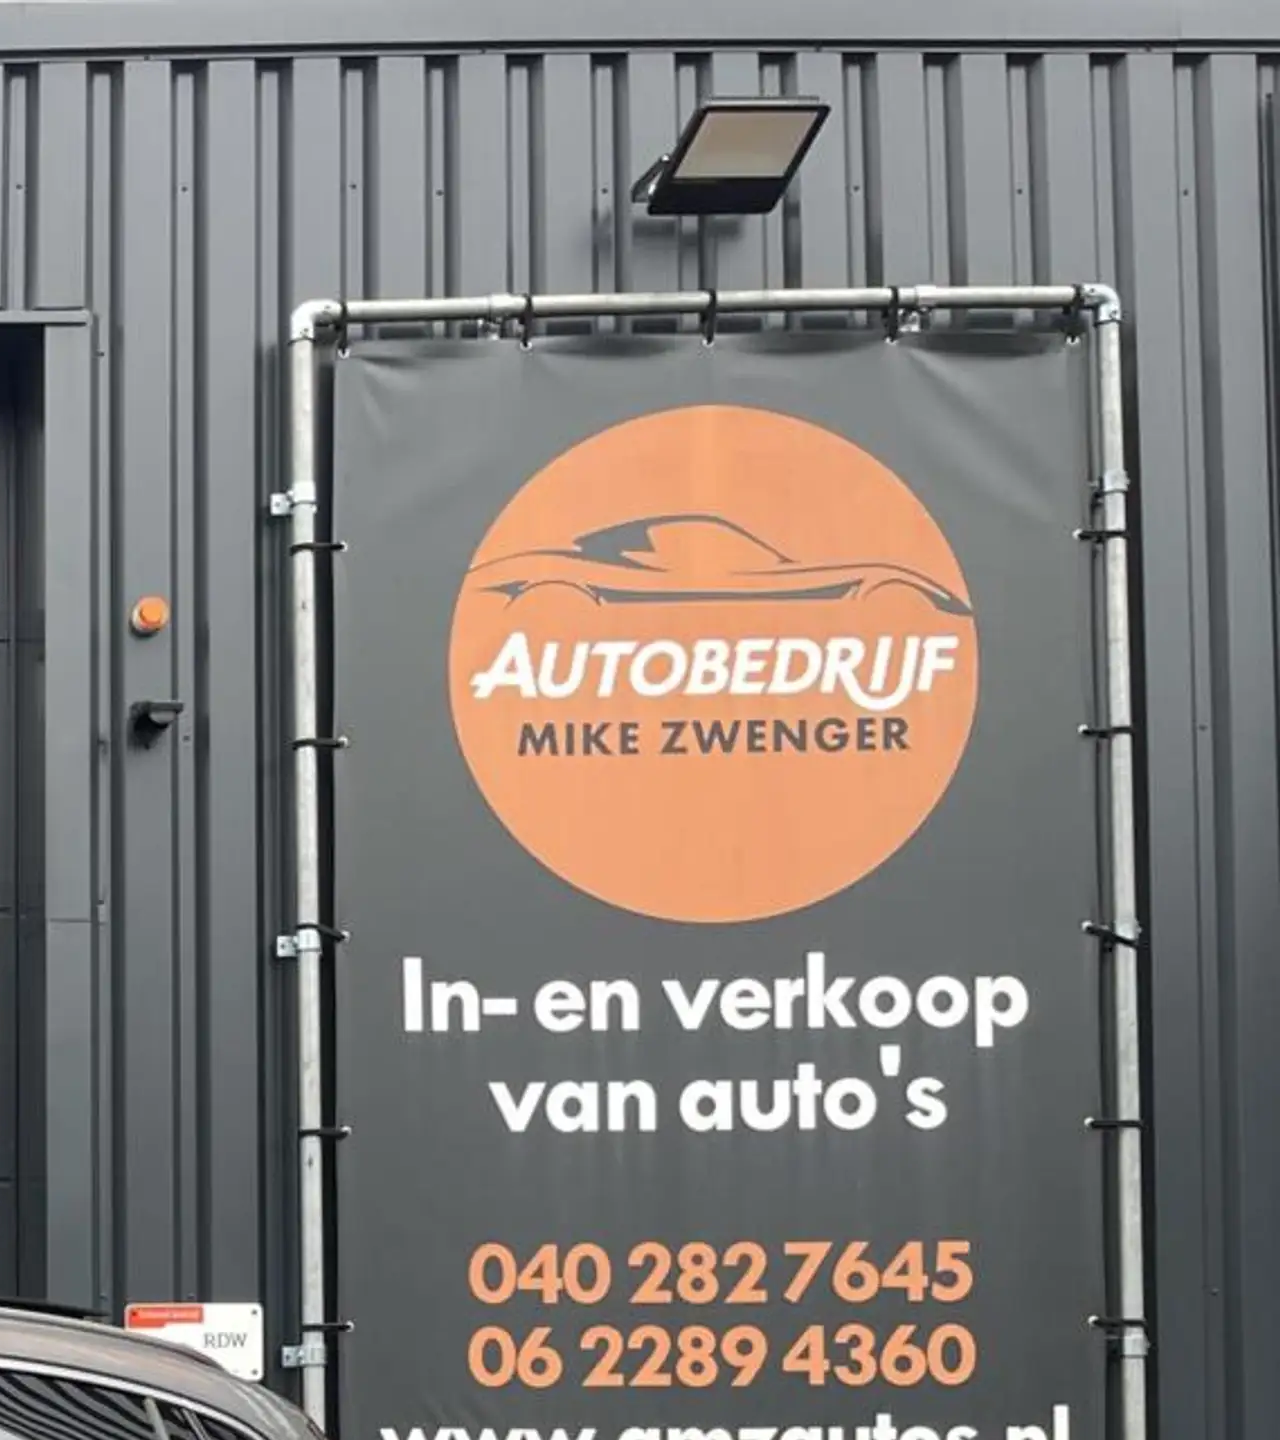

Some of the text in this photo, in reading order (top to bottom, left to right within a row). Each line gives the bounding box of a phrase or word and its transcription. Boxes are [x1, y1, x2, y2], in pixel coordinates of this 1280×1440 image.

[470, 632, 959, 711] AUTOBEDRIJF
[517, 717, 911, 757] MIKE ZWENGER
[402, 951, 1029, 1048] In- en verkoop
[488, 1044, 948, 1133] van auto's
[469, 1240, 973, 1305] 040 282 7645
[202, 1331, 248, 1349] RDW
[469, 1323, 977, 1388] 06 2289 4360
